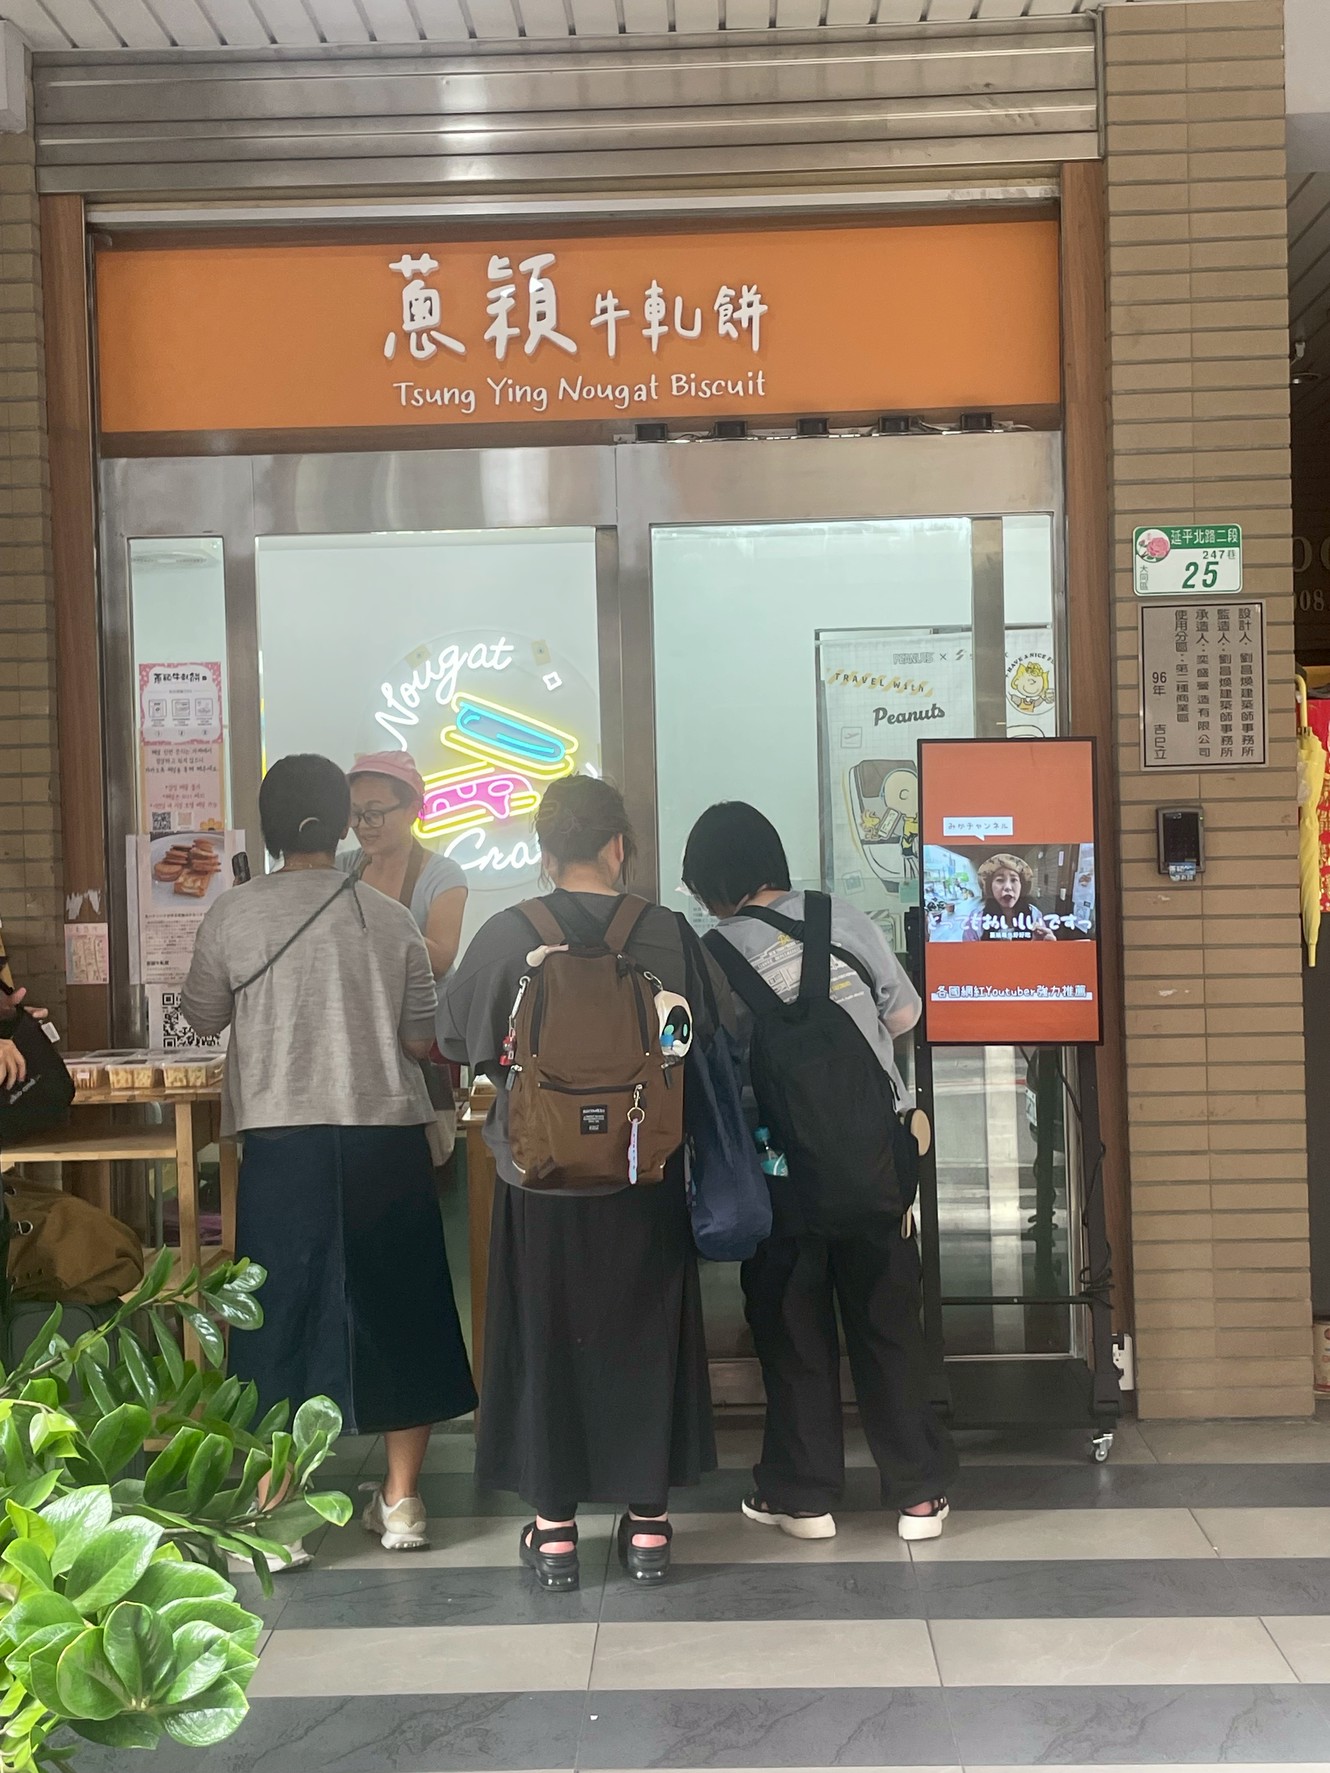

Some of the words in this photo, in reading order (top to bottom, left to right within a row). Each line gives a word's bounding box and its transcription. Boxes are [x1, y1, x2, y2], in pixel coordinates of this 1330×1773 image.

[393, 382, 476, 413] Tsung
[486, 376, 548, 411] Ying
[558, 374, 659, 408] Nougat
[670, 370, 767, 398] Biscuit
[1170, 527, 1239, 545] 延平北路二段
[1181, 560, 1220, 590] 25
[834, 672, 885, 687] TRAVEL
[374, 636, 515, 753] Nougat
[872, 703, 946, 726] Peanuts
